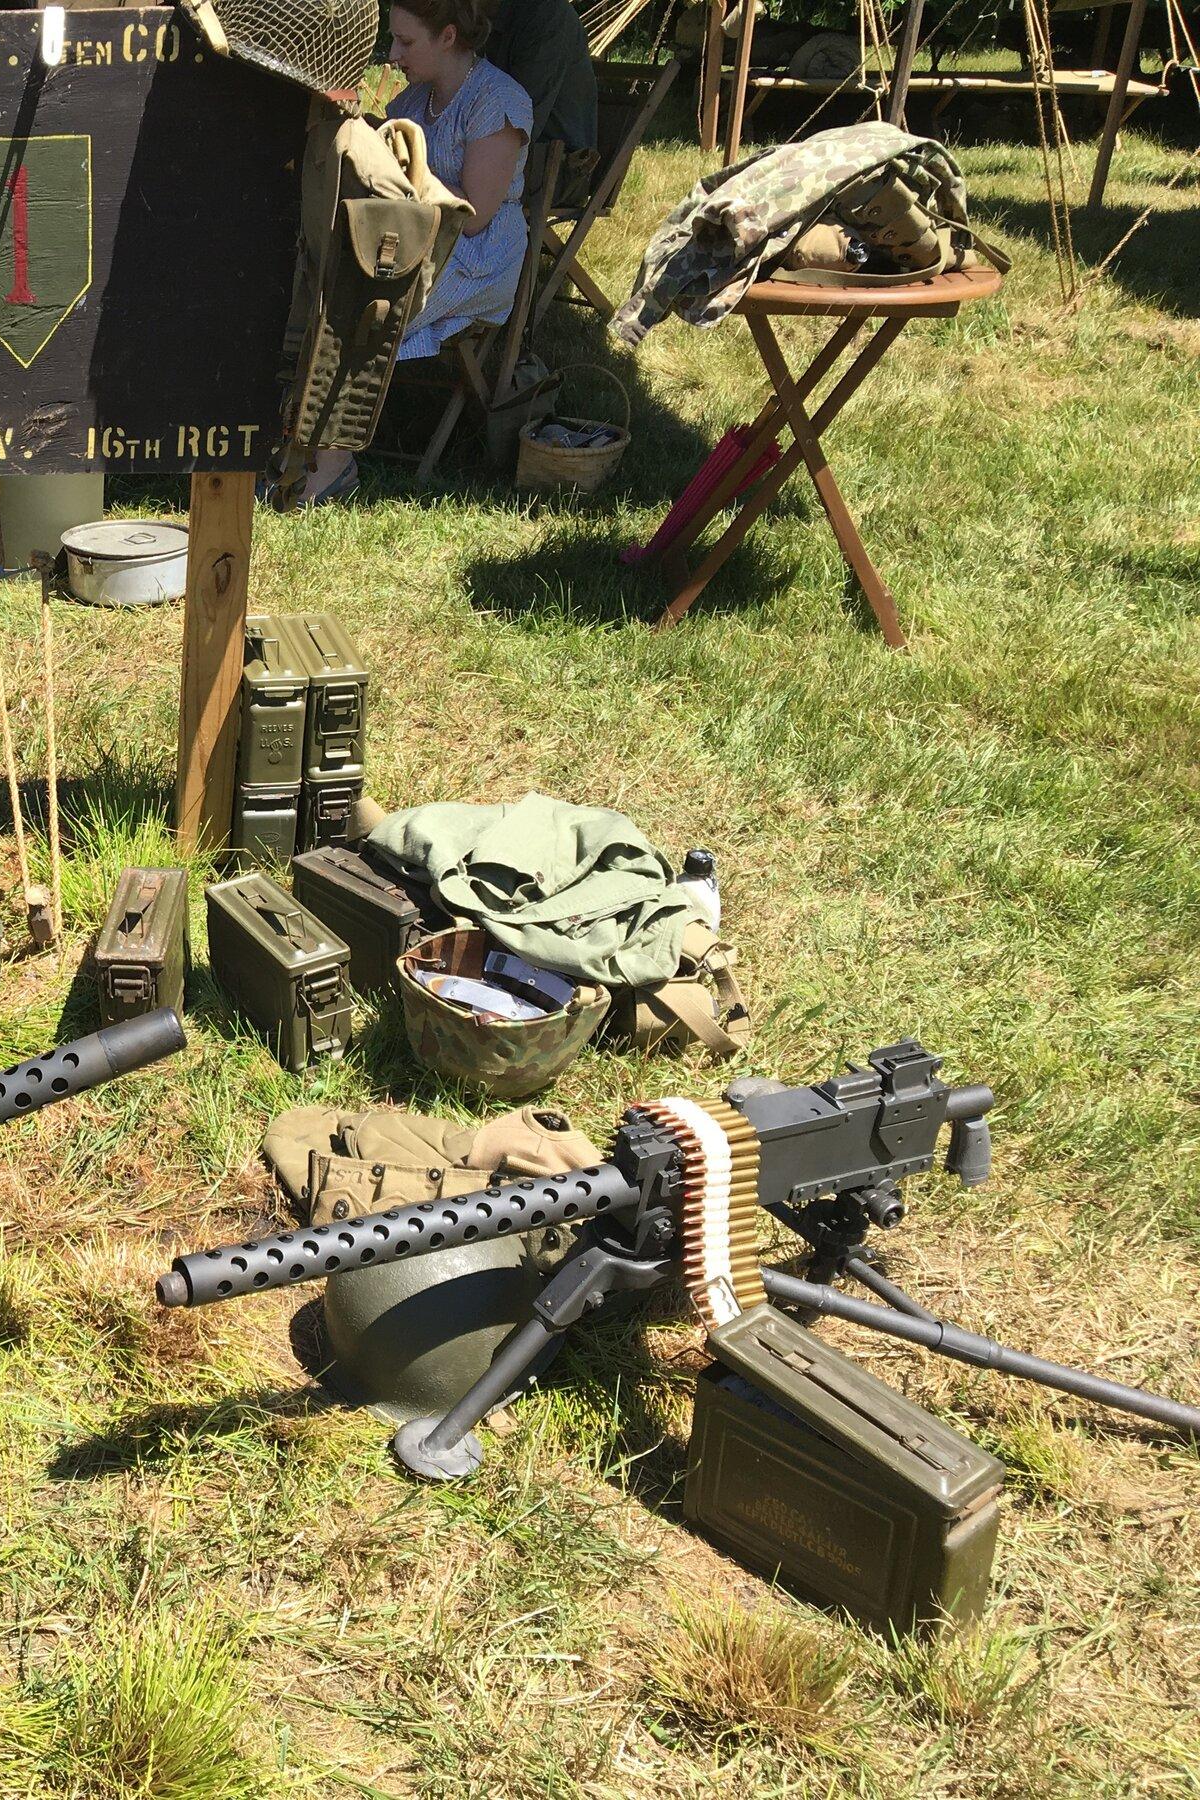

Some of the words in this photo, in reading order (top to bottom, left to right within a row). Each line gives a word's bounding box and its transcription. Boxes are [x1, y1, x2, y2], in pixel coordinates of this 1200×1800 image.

[52, 35, 112, 66] TEM
[123, 23, 204, 64] CO.
[86, 426, 161, 459] 16TH
